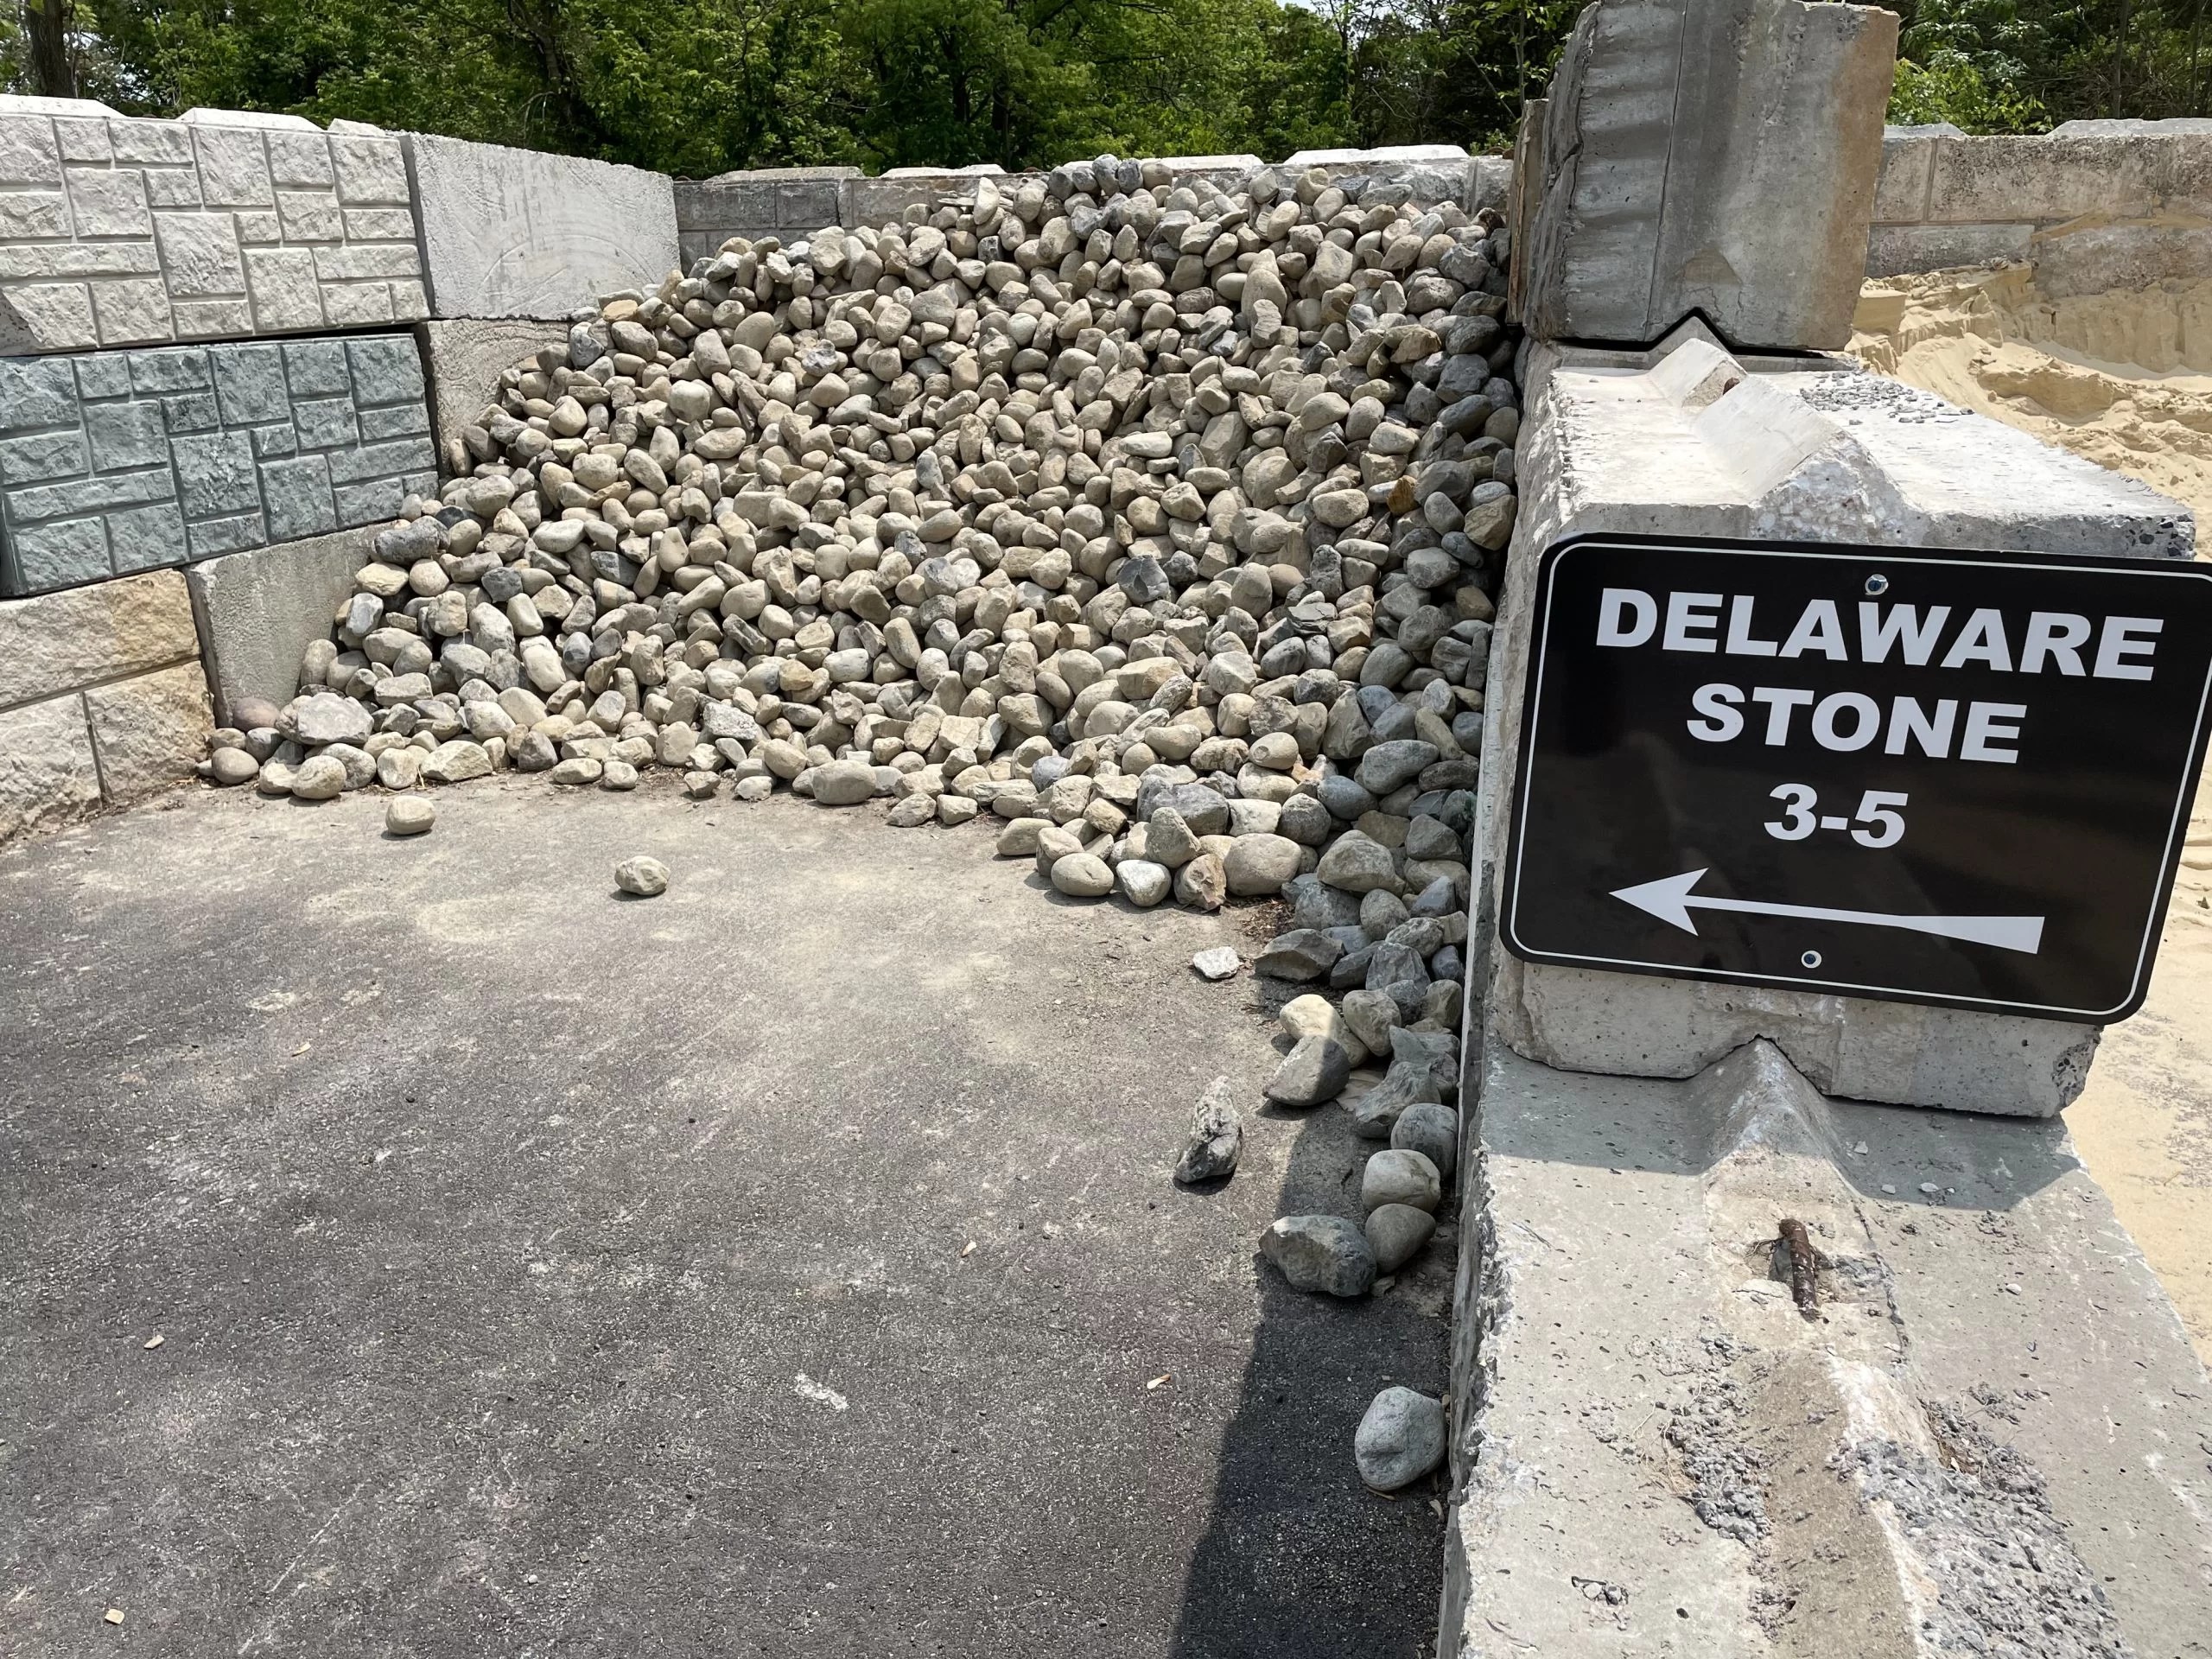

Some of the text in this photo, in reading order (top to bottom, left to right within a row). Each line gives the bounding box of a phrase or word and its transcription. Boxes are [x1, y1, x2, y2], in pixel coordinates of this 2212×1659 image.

[1596, 588, 2164, 681] DELAWARE
[1687, 683, 2027, 764] STONE
[1764, 783, 1909, 849] 3-5
